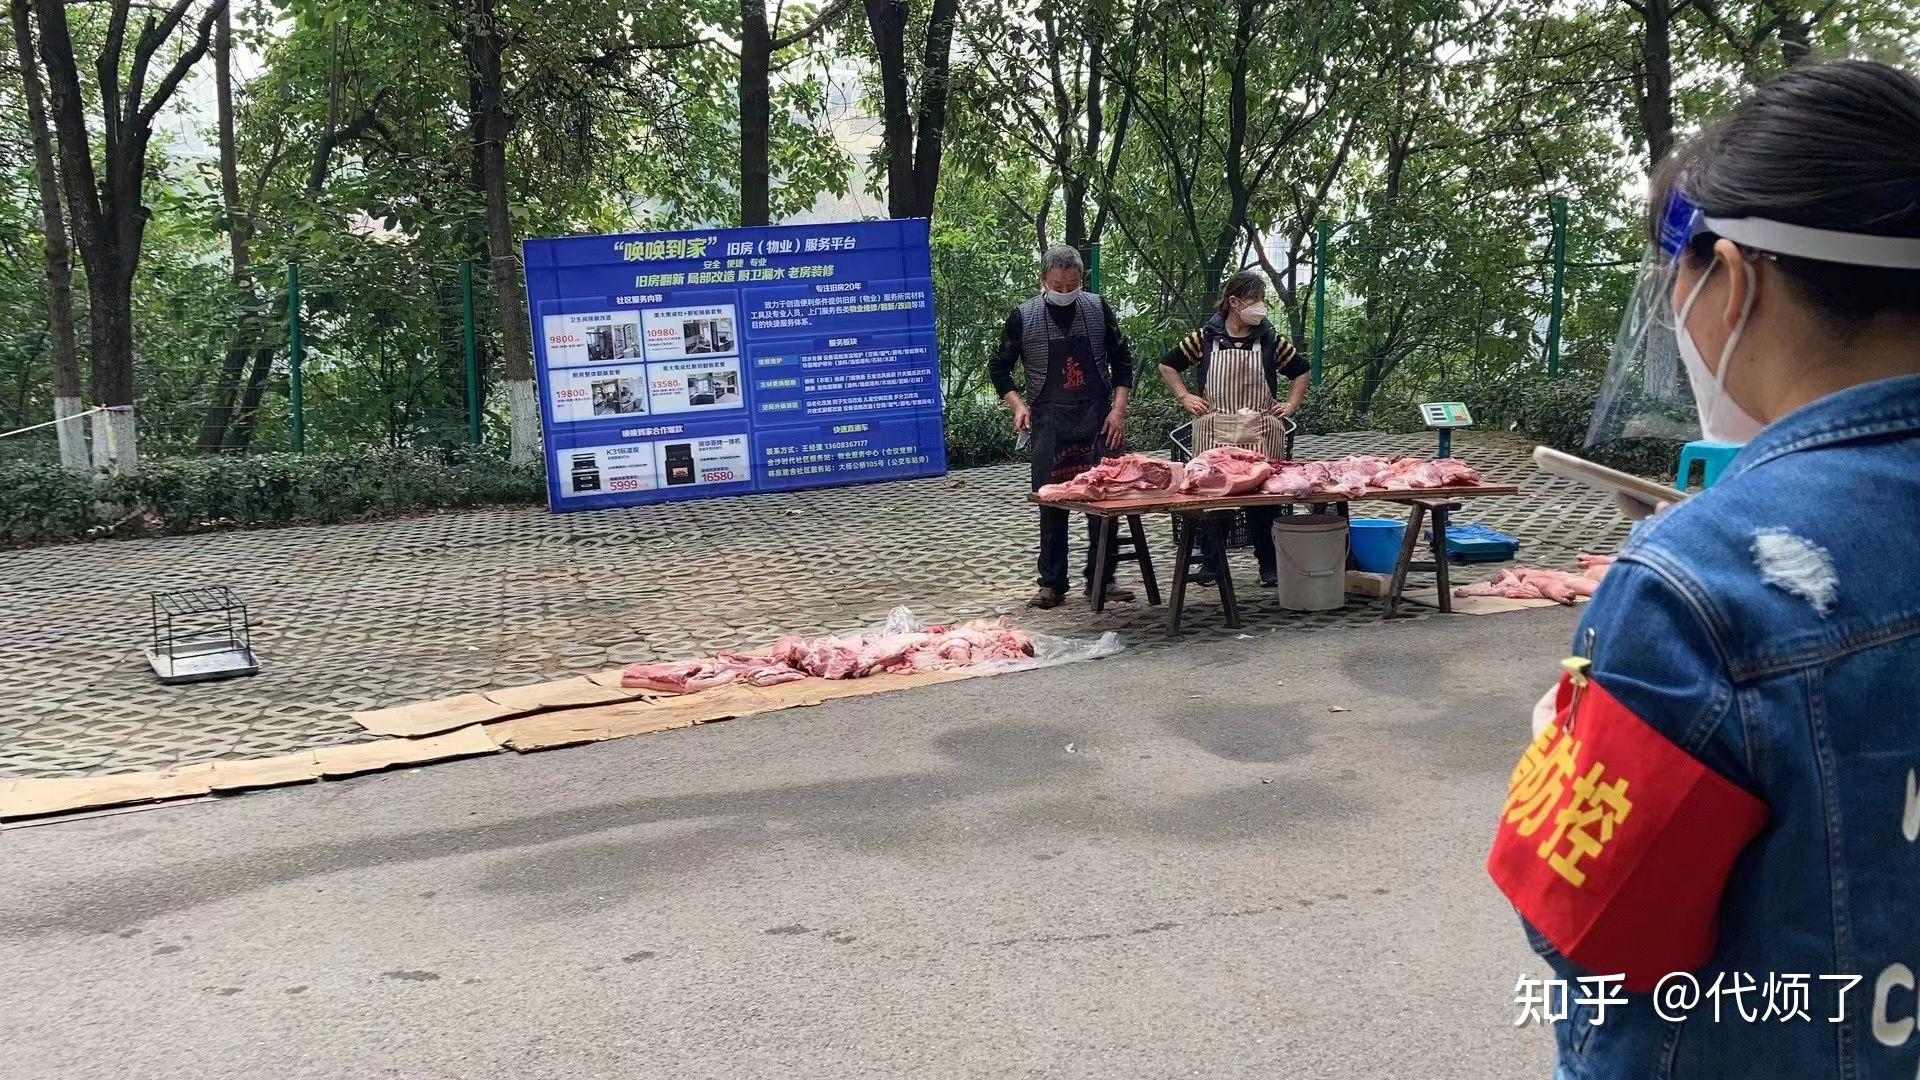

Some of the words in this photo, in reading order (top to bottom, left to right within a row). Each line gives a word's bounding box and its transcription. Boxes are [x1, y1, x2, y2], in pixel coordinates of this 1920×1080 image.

[703, 261, 720, 269] 安全
[749, 258, 767, 266] 专业
[634, 273, 683, 287] 旧房翻新
[686, 270, 735, 284] 局部改造
[737, 267, 785, 281] 厨卫漏水
[787, 264, 834, 278] 老房装修
[828, 338, 858, 347] 服务板块
[701, 471, 733, 482] 16580
[610, 480, 637, 490] 5999
